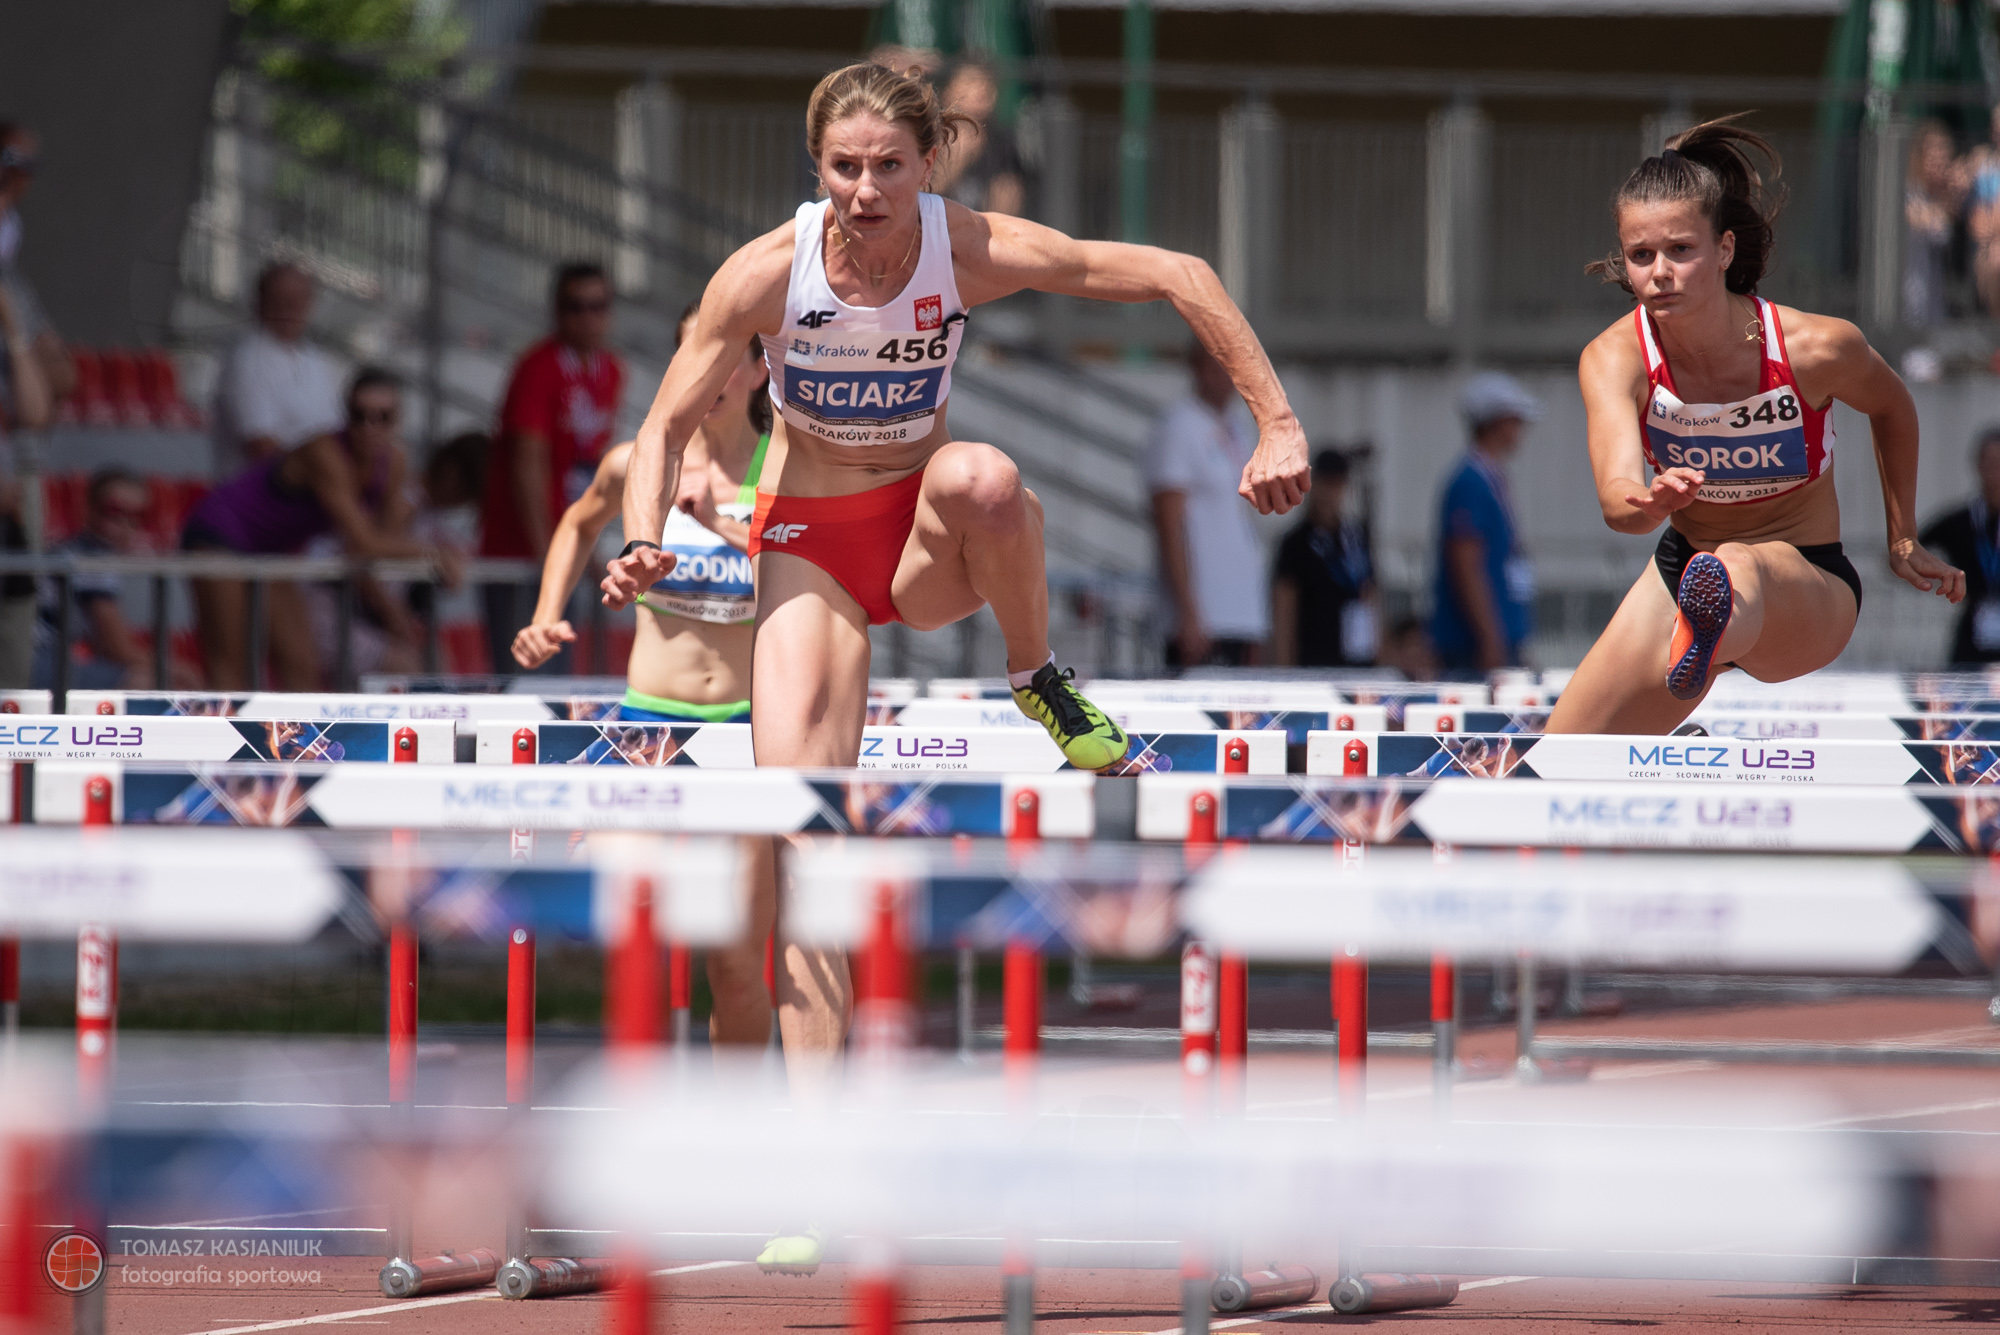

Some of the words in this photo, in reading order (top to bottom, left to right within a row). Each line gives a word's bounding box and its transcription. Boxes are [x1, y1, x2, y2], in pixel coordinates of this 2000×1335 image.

[915, 296, 940, 306] POLSKA
[797, 310, 837, 329] 4F
[815, 343, 869, 358] Kraków
[876, 336, 948, 364] 456
[797, 378, 928, 408] SICIARZ
[906, 411, 929, 420] POLSKA
[1671, 411, 1721, 427] Kraków
[1729, 394, 1799, 429] 348
[808, 422, 871, 441] KRAKÓW
[874, 428, 907, 440] 2018
[1666, 442, 1785, 470] SOROK
[1698, 488, 1741, 499] AKÓW
[1746, 487, 1779, 497] 2018
[762, 523, 809, 544] 4F
[665, 553, 753, 585] GODN
[722, 606, 747, 617] 2018
[0, 725, 59, 745] ECZ
[72, 726, 143, 746] U23
[8, 750, 52, 758] SŁOWENIA
[66, 751, 96, 759] WĘGRY
[897, 738, 968, 757] U23
[891, 762, 921, 770] WĘGRY
[1629, 745, 1729, 767] MECZ
[1742, 748, 1815, 770] U23
[1676, 771, 1722, 780] SŁOWENIA
[1736, 773, 1767, 781] WĘGRY
[1781, 774, 1815, 782] POLSKA
